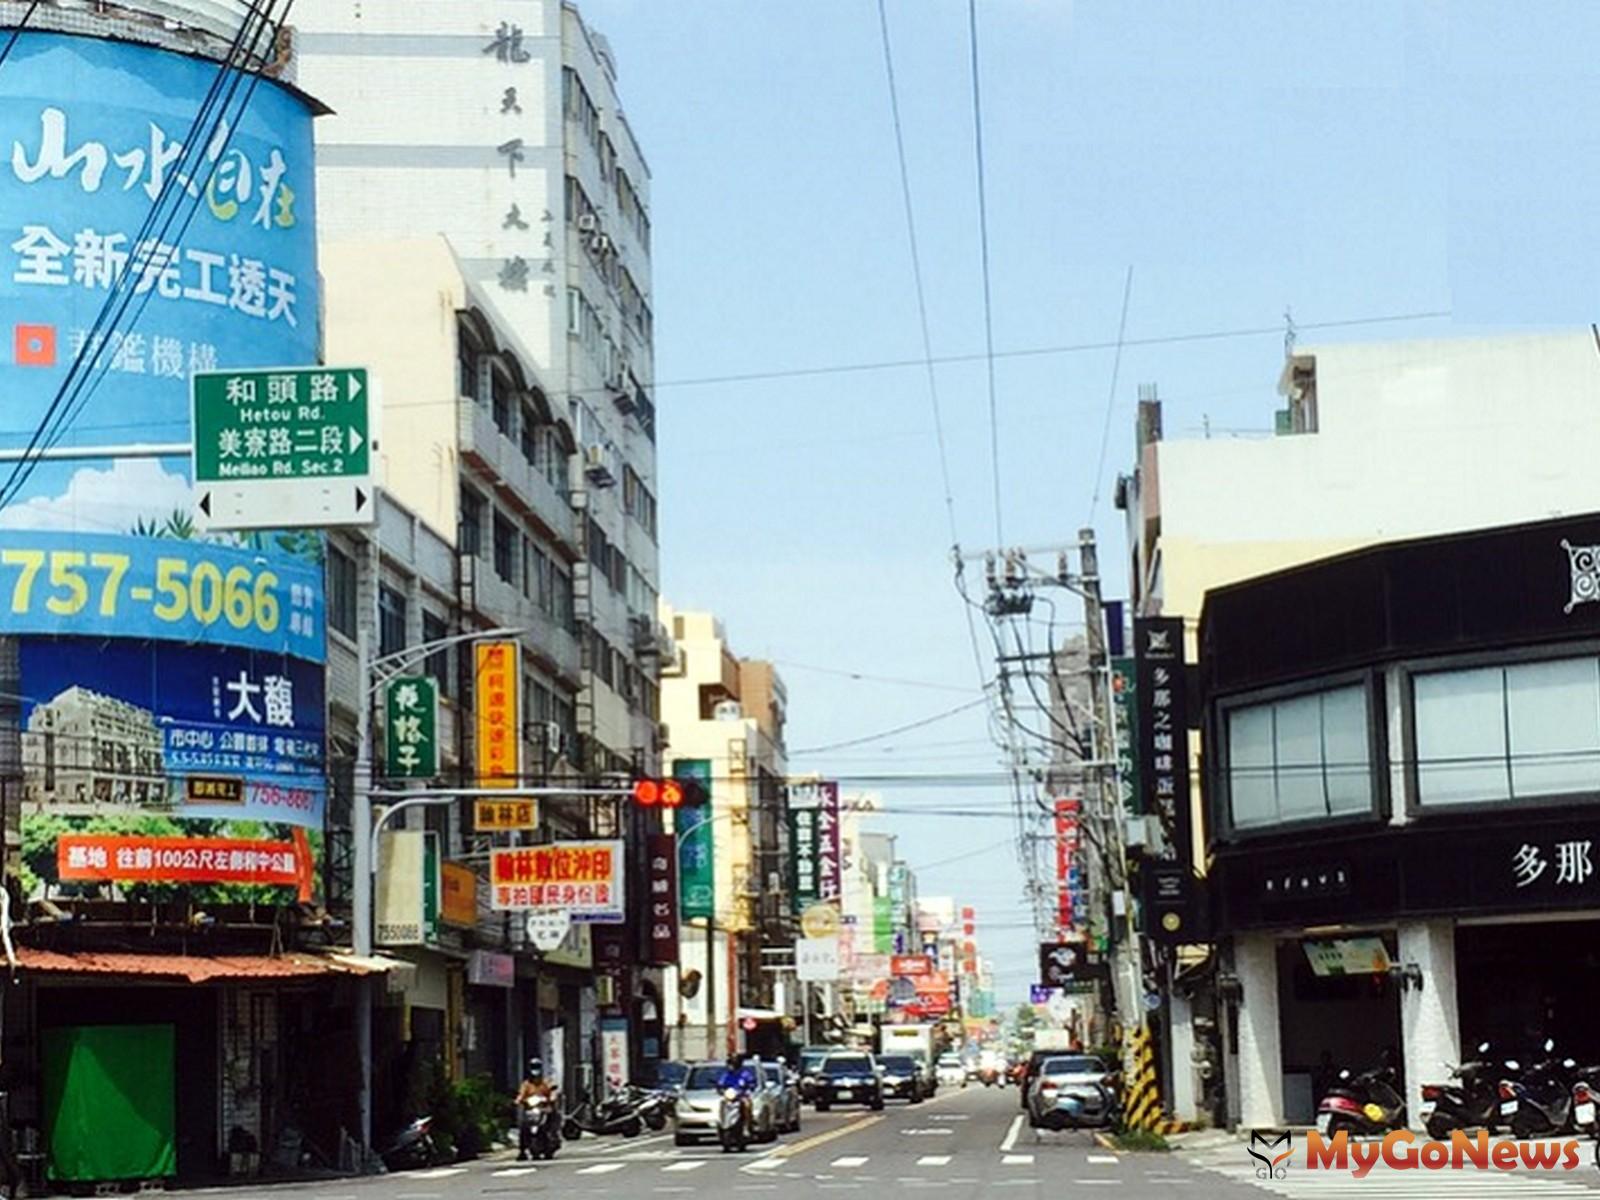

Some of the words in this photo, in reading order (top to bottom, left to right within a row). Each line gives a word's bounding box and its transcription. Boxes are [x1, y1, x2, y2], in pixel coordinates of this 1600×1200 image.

[12, 225, 298, 328] 全新完工透天
[226, 373, 338, 406] 和頭路
[240, 406, 292, 423] Hetou
[298, 405, 326, 420] Rd.
[2, 549, 280, 633] 757-5066
[1512, 840, 1594, 888] 多那
